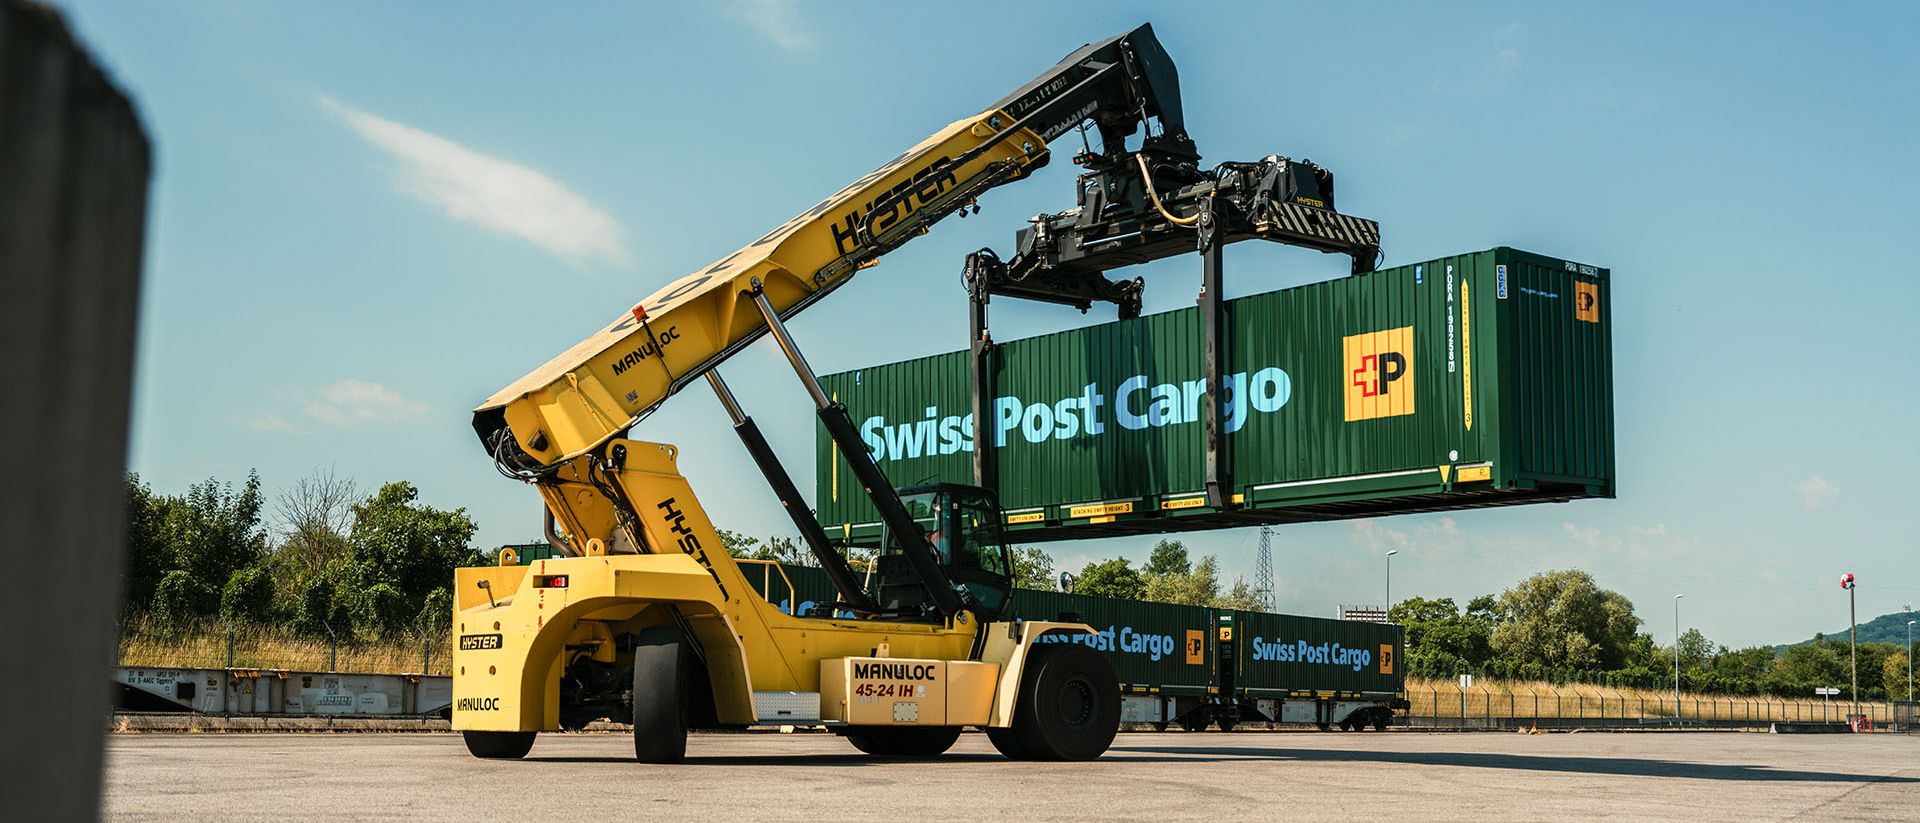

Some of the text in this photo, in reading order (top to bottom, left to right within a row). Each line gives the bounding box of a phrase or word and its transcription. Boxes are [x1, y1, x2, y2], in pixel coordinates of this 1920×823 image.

[1297, 196, 1323, 208] HYSTER
[612, 326, 680, 376] MANUOC
[1379, 352, 1406, 395] P
[861, 367, 1291, 464] Swiss Post Cargo
[1126, 503, 1130, 511] 3
[657, 497, 730, 602] HYST
[462, 635, 498, 650] HYSTER
[1120, 626, 1174, 662] Cargo
[1252, 636, 1371, 672] Swiss Post Cargo
[855, 663, 935, 680] MANULOC
[856, 683, 914, 697] 45-24 IH
[457, 697, 500, 711] MANULOC
